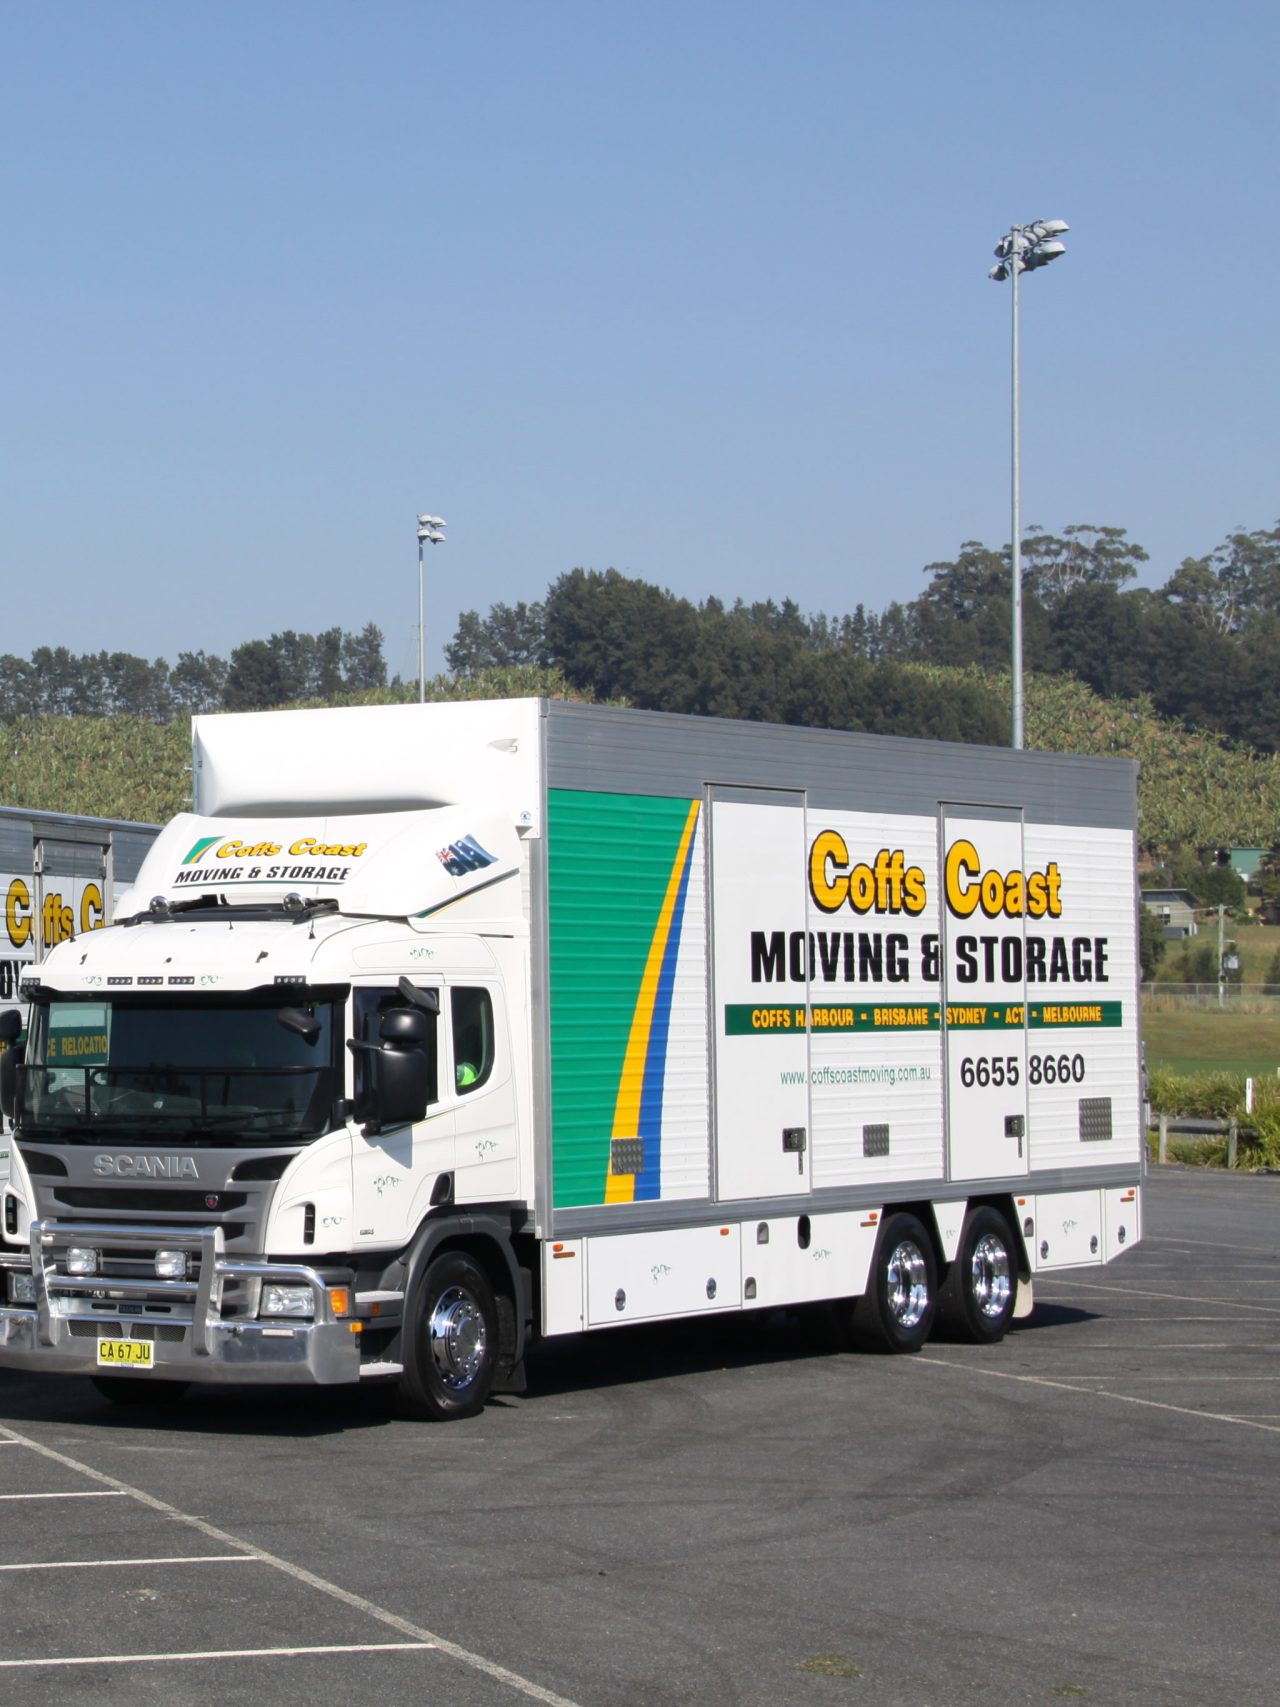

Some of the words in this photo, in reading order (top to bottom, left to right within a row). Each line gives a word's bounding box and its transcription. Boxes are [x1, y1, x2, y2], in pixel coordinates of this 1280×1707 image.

[216, 840, 282, 858] Coffs
[288, 838, 368, 857] Coast
[174, 867, 244, 884] MOVING
[248, 866, 262, 878] &
[267, 866, 352, 880] STORAGE
[808, 829, 927, 917] Coffs
[945, 839, 1062, 919] Coast
[751, 931, 909, 982] MOVING
[921, 934, 943, 982] &
[956, 935, 1109, 983] STORAGE
[752, 1009, 791, 1028] COFFS
[795, 1008, 854, 1027] HARBOUR
[874, 1008, 929, 1026] BRISBANE
[946, 1007, 987, 1024] SYDNEY
[1005, 1007, 1024, 1023] ACT
[1043, 1006, 1102, 1023] MELBOURNE
[960, 1056, 1019, 1087] 6655
[1029, 1053, 1085, 1085] 8660
[93, 1154, 199, 1178] SCANIA
[100, 1343, 114, 1357] CA
[118, 1344, 132, 1358] 67
[136, 1344, 150, 1359] JU
